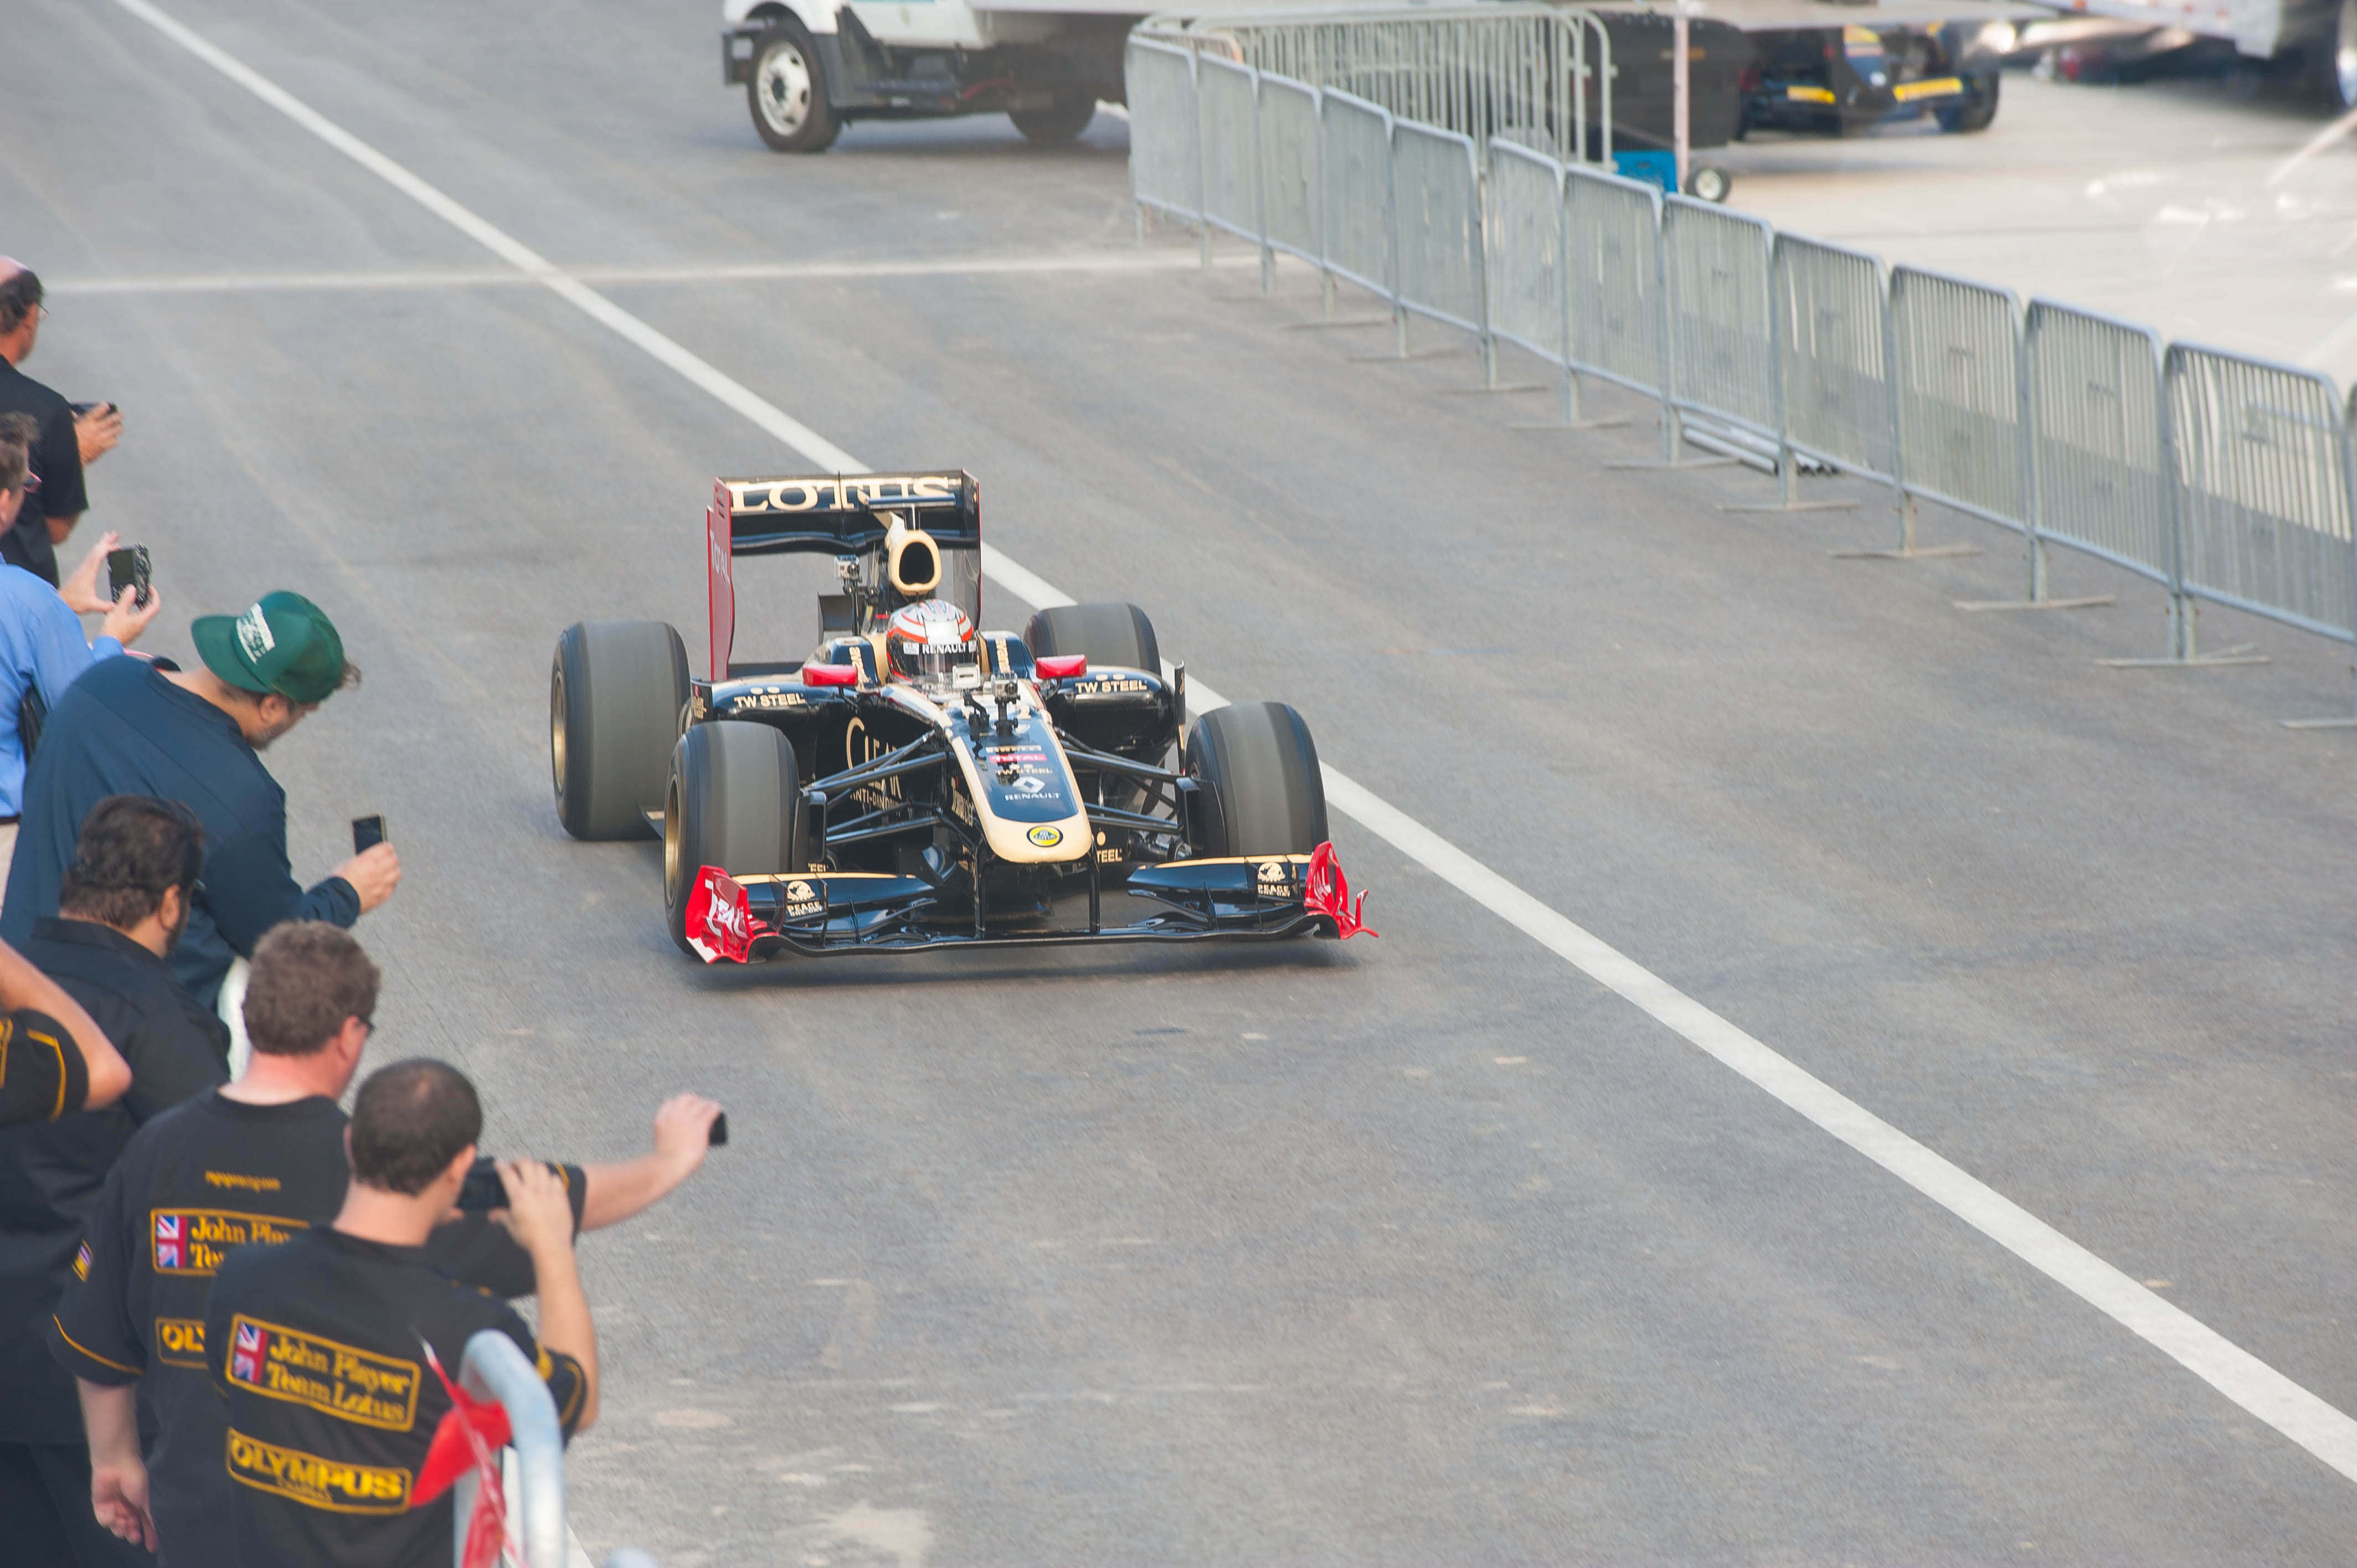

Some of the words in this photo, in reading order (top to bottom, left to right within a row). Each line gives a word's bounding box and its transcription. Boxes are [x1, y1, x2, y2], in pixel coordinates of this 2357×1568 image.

[922, 643, 966, 654] RENAULT
[1075, 682, 1098, 694] TW
[1102, 680, 1147, 693] STEEL
[734, 695, 756, 708] TW
[760, 693, 806, 707] STEEL
[1005, 792, 1061, 801] RENAULT
[1096, 848, 1122, 864] TEEL
[191, 1216, 246, 1245] John
[269, 1334, 329, 1375] John
[334, 1352, 411, 1395] Player
[266, 1361, 332, 1404] Team
[333, 1381, 406, 1421] Lotus
[231, 1440, 403, 1499] OLYMPUS
